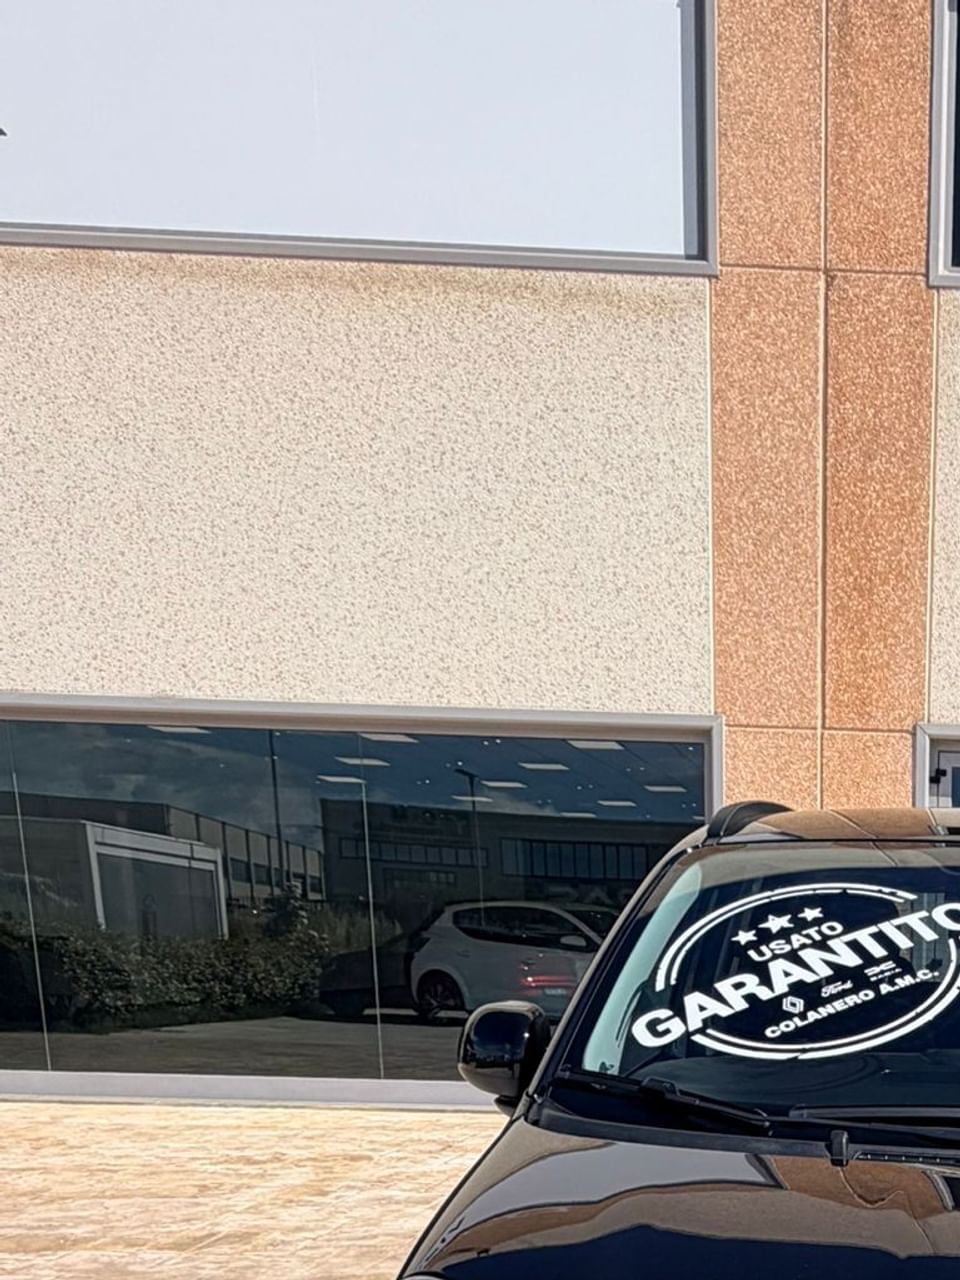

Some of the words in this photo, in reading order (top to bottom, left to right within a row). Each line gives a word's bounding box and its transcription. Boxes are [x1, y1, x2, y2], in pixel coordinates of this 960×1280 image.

[747, 921, 844, 962] USATO
[764, 989, 875, 1038] COLANERO
[879, 968, 940, 995] A.M.C.
[821, 980, 853, 998] Ford
